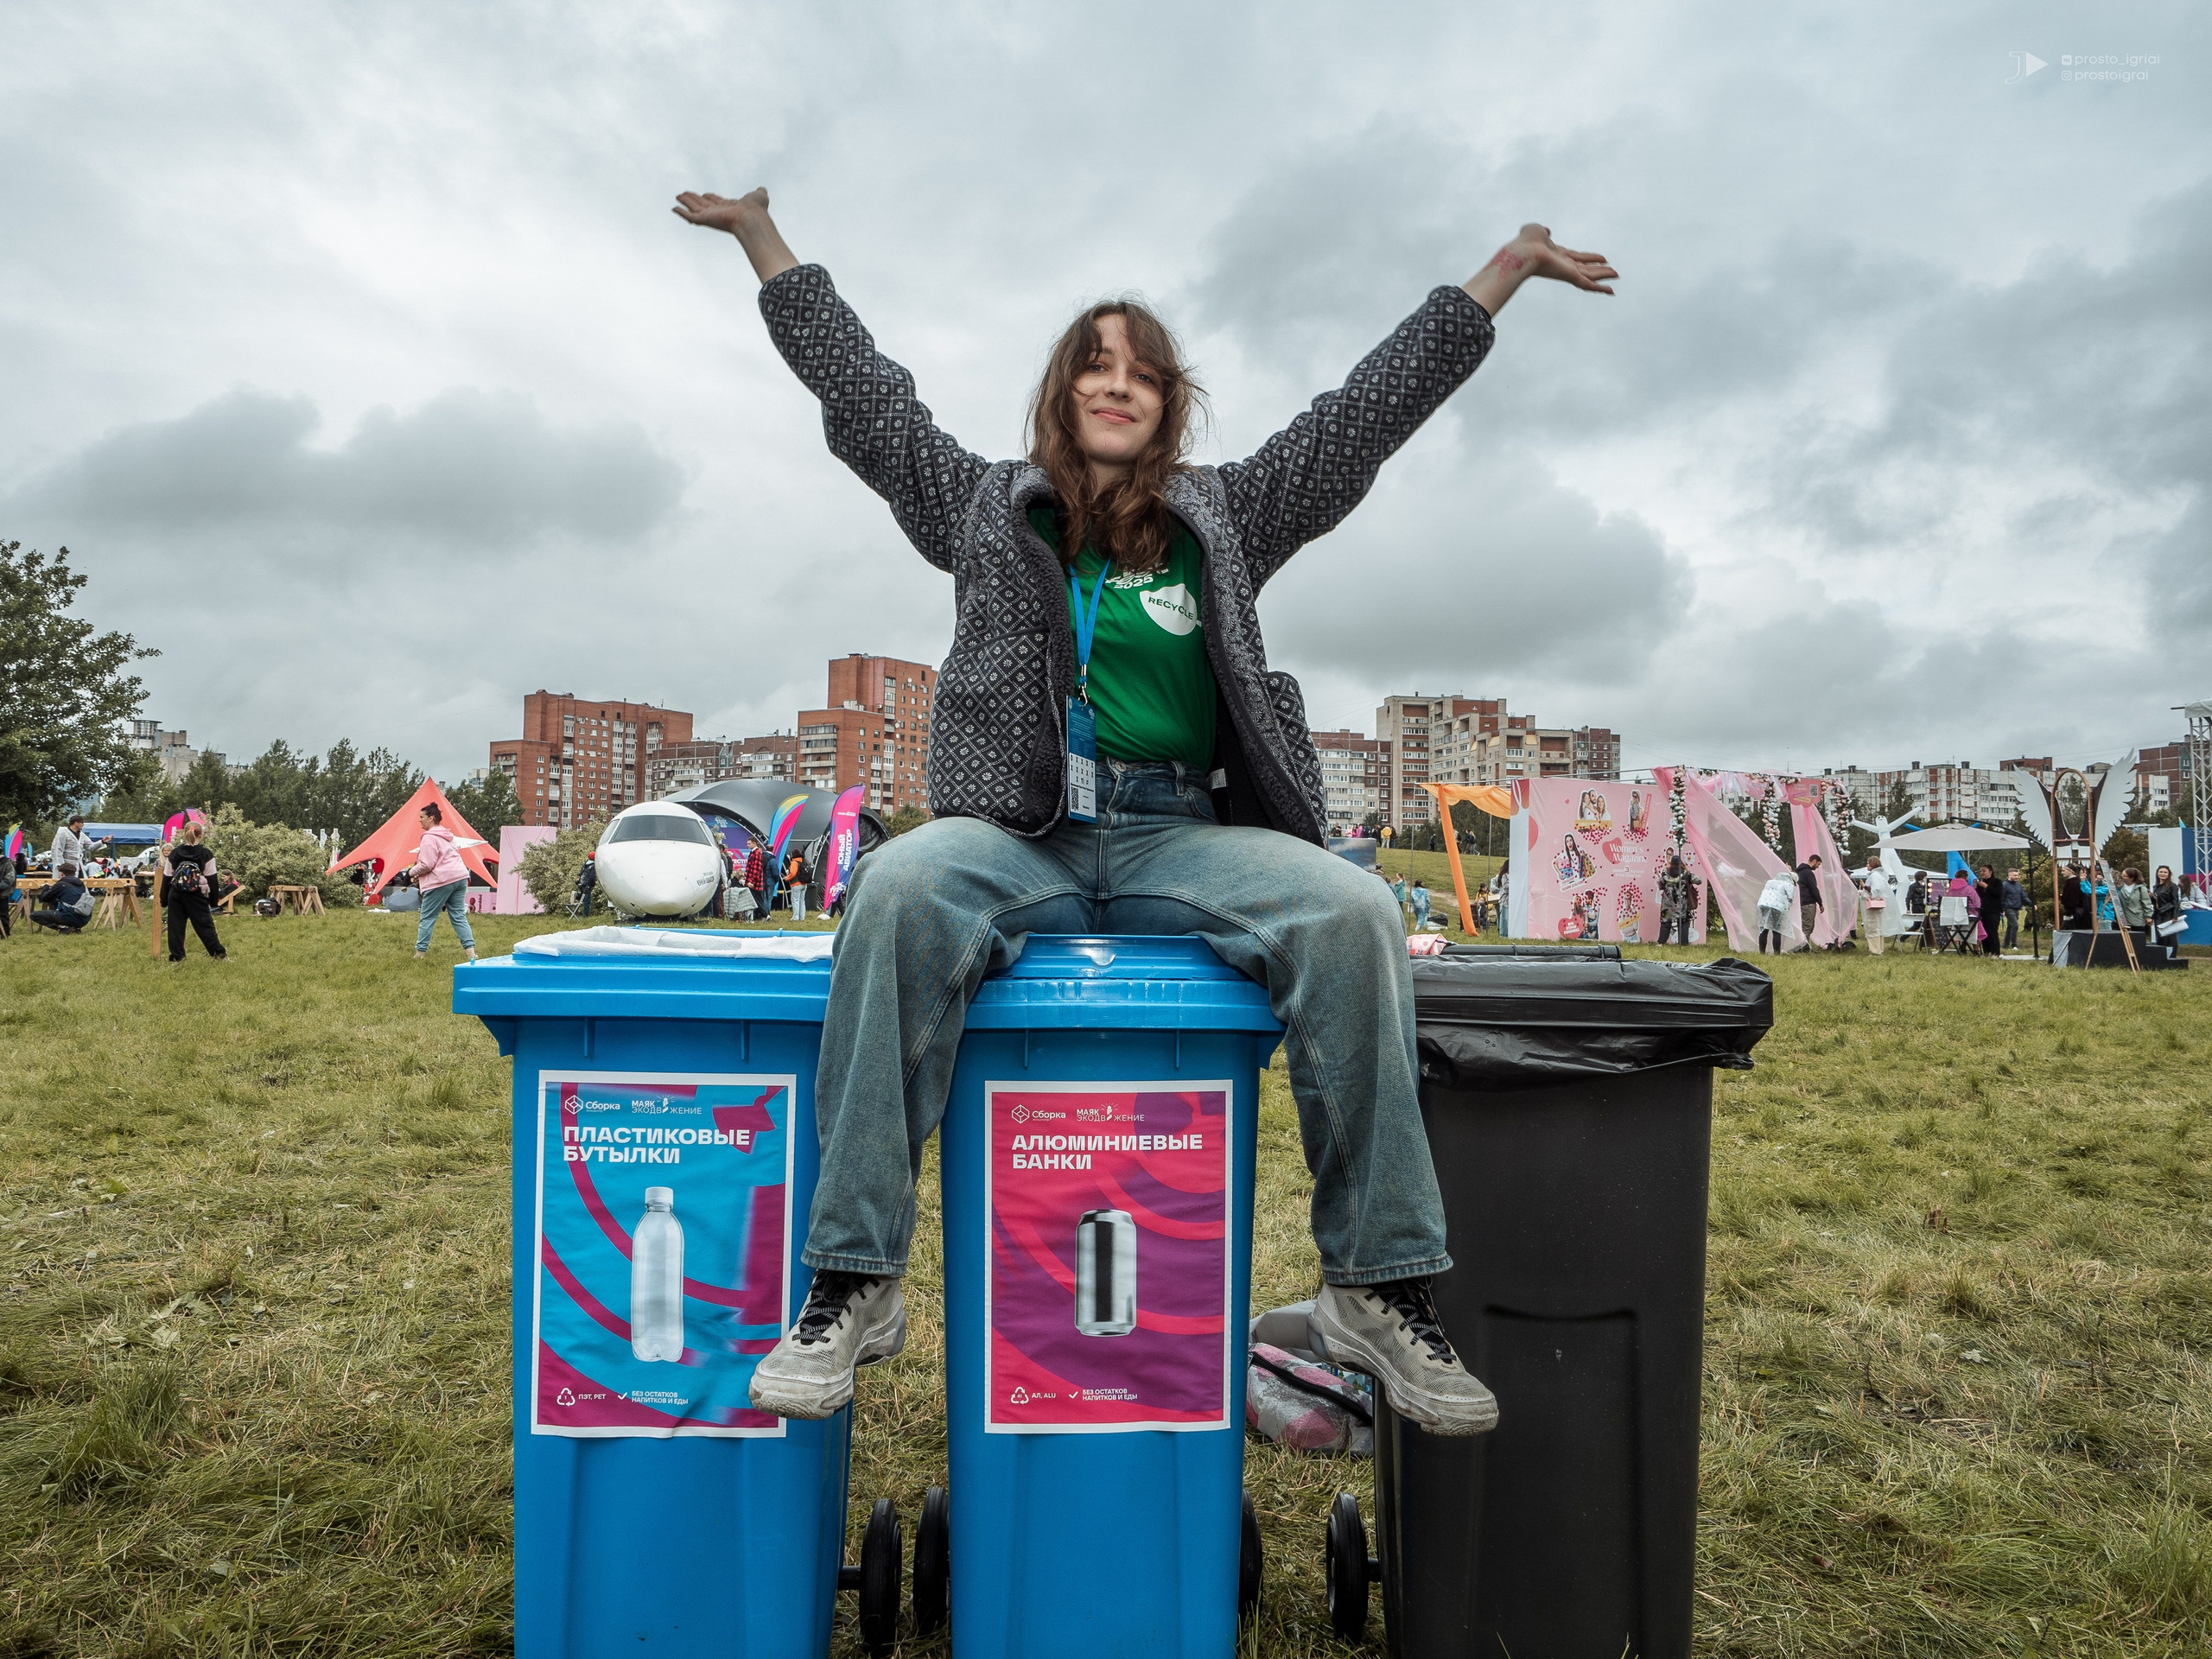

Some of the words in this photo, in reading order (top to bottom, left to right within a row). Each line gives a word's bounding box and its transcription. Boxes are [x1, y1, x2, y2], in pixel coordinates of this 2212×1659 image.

[1114, 574, 1154, 589] 2025
[1148, 596, 1193, 620] RECYCLE
[837, 834, 846, 865] ЮНЫЙ
[842, 829, 853, 872] АВИАТОР
[1609, 843, 1643, 853] Women's
[1612, 853, 1648, 864] Magazine
[585, 1101, 620, 1111] Сборка
[1032, 1110, 1066, 1121] Сборка
[564, 1126, 750, 1146] ПЛАСТИКОВЫЕ
[1012, 1134, 1203, 1151] АЛЮМИНИЕВЫЕ
[563, 1145, 680, 1164] БУТЫЛКИ
[1013, 1154, 1092, 1170] БАНКИ
